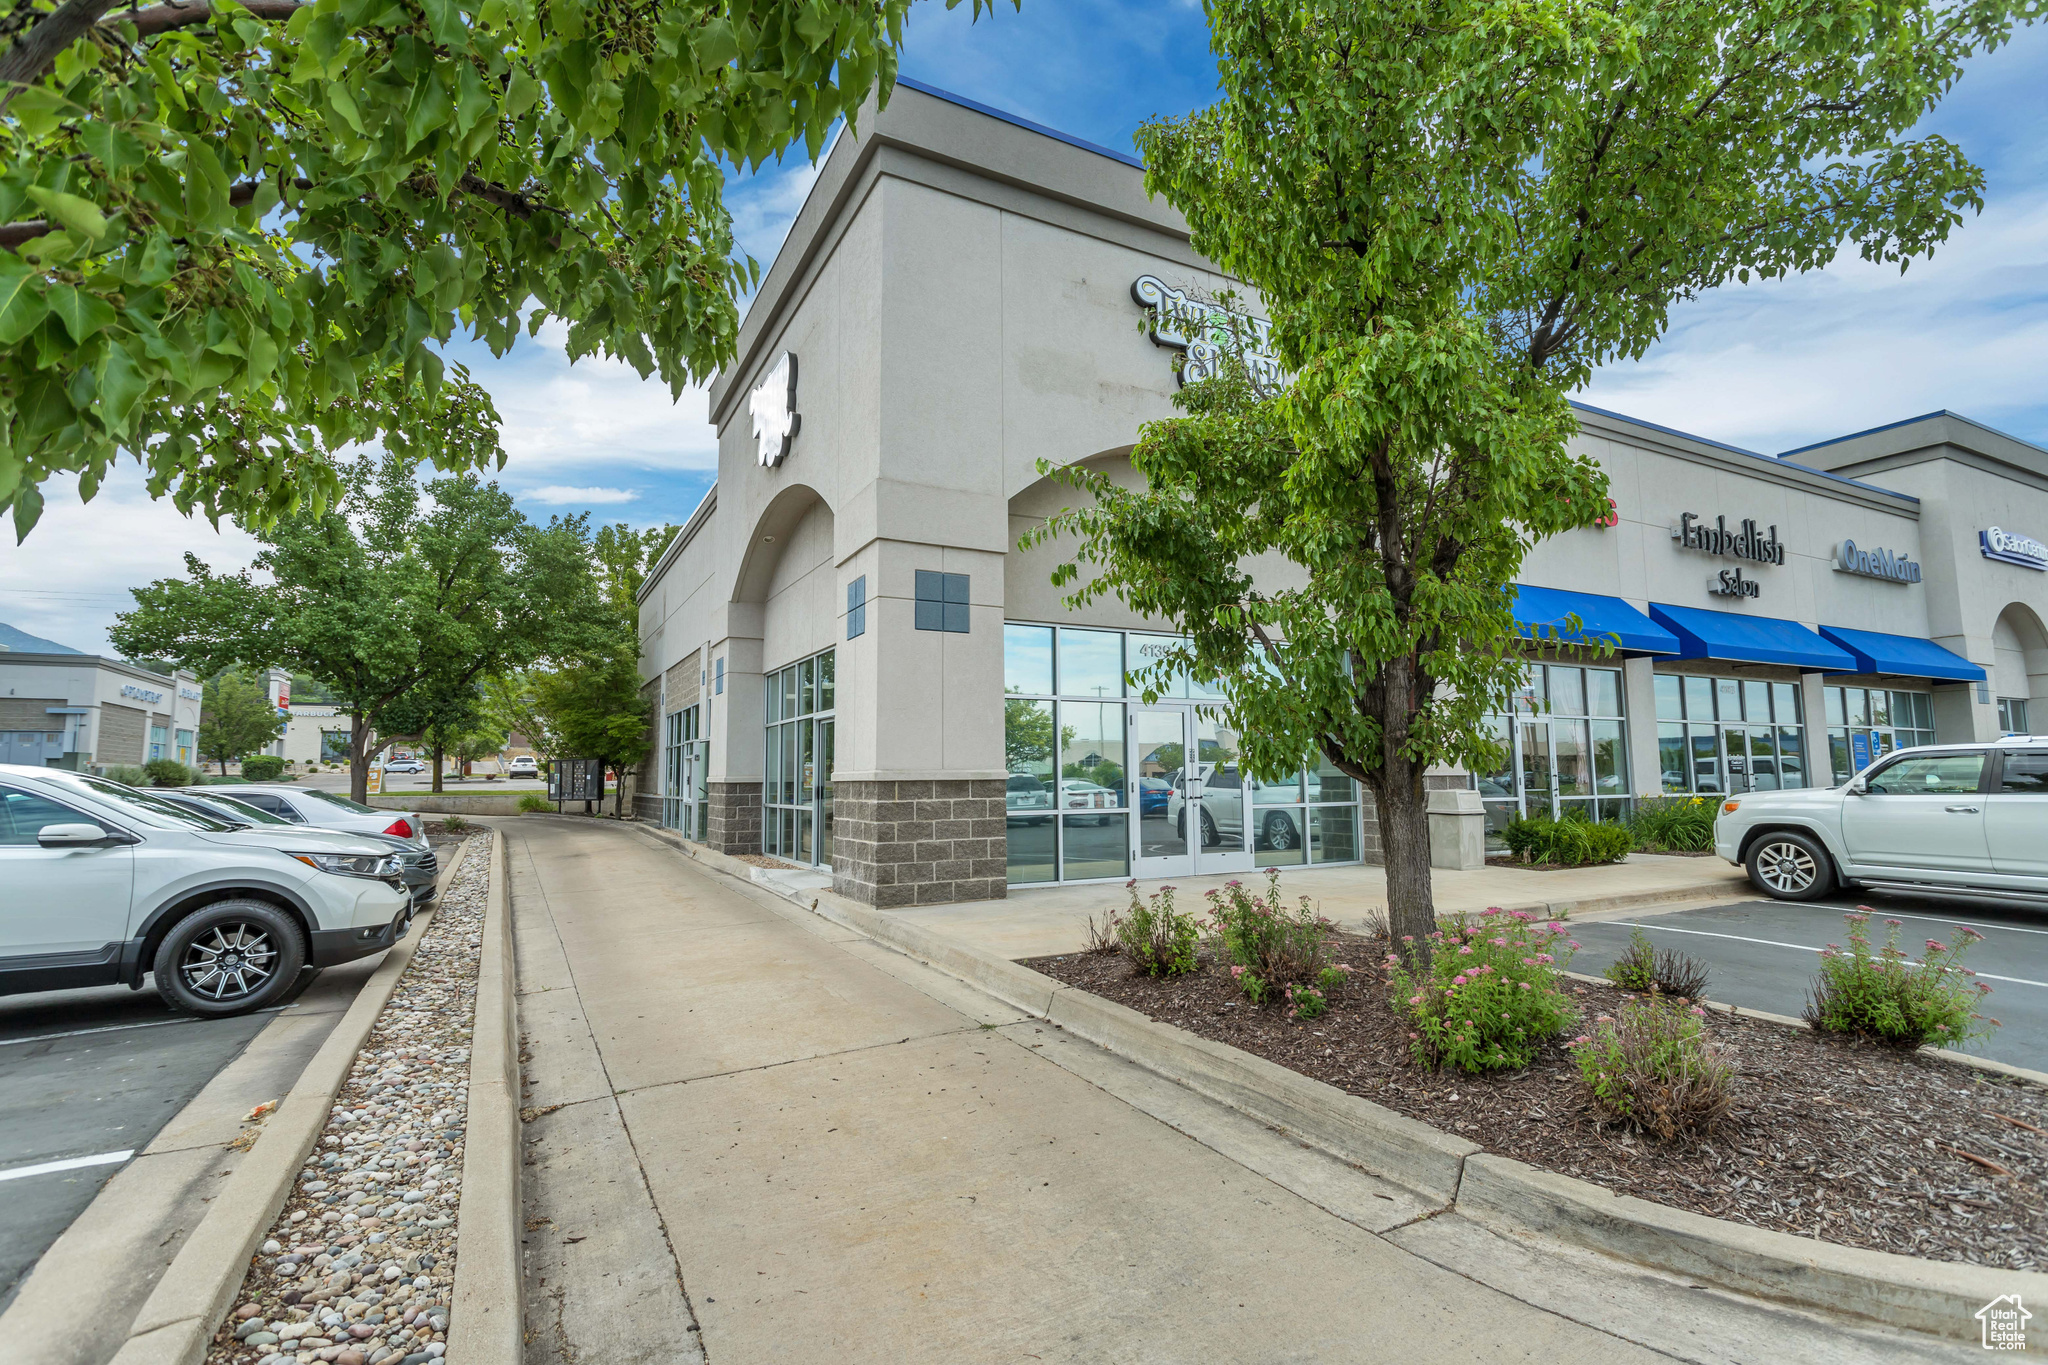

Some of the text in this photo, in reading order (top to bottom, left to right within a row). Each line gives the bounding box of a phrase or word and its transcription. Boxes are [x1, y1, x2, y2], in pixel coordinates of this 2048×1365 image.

[1189, 343, 1283, 396] SAR
[1680, 511, 1785, 566] Embellish
[1838, 538, 1921, 583] OneMain
[1718, 567, 1760, 598] Salon
[1140, 643, 1171, 658] 4139
